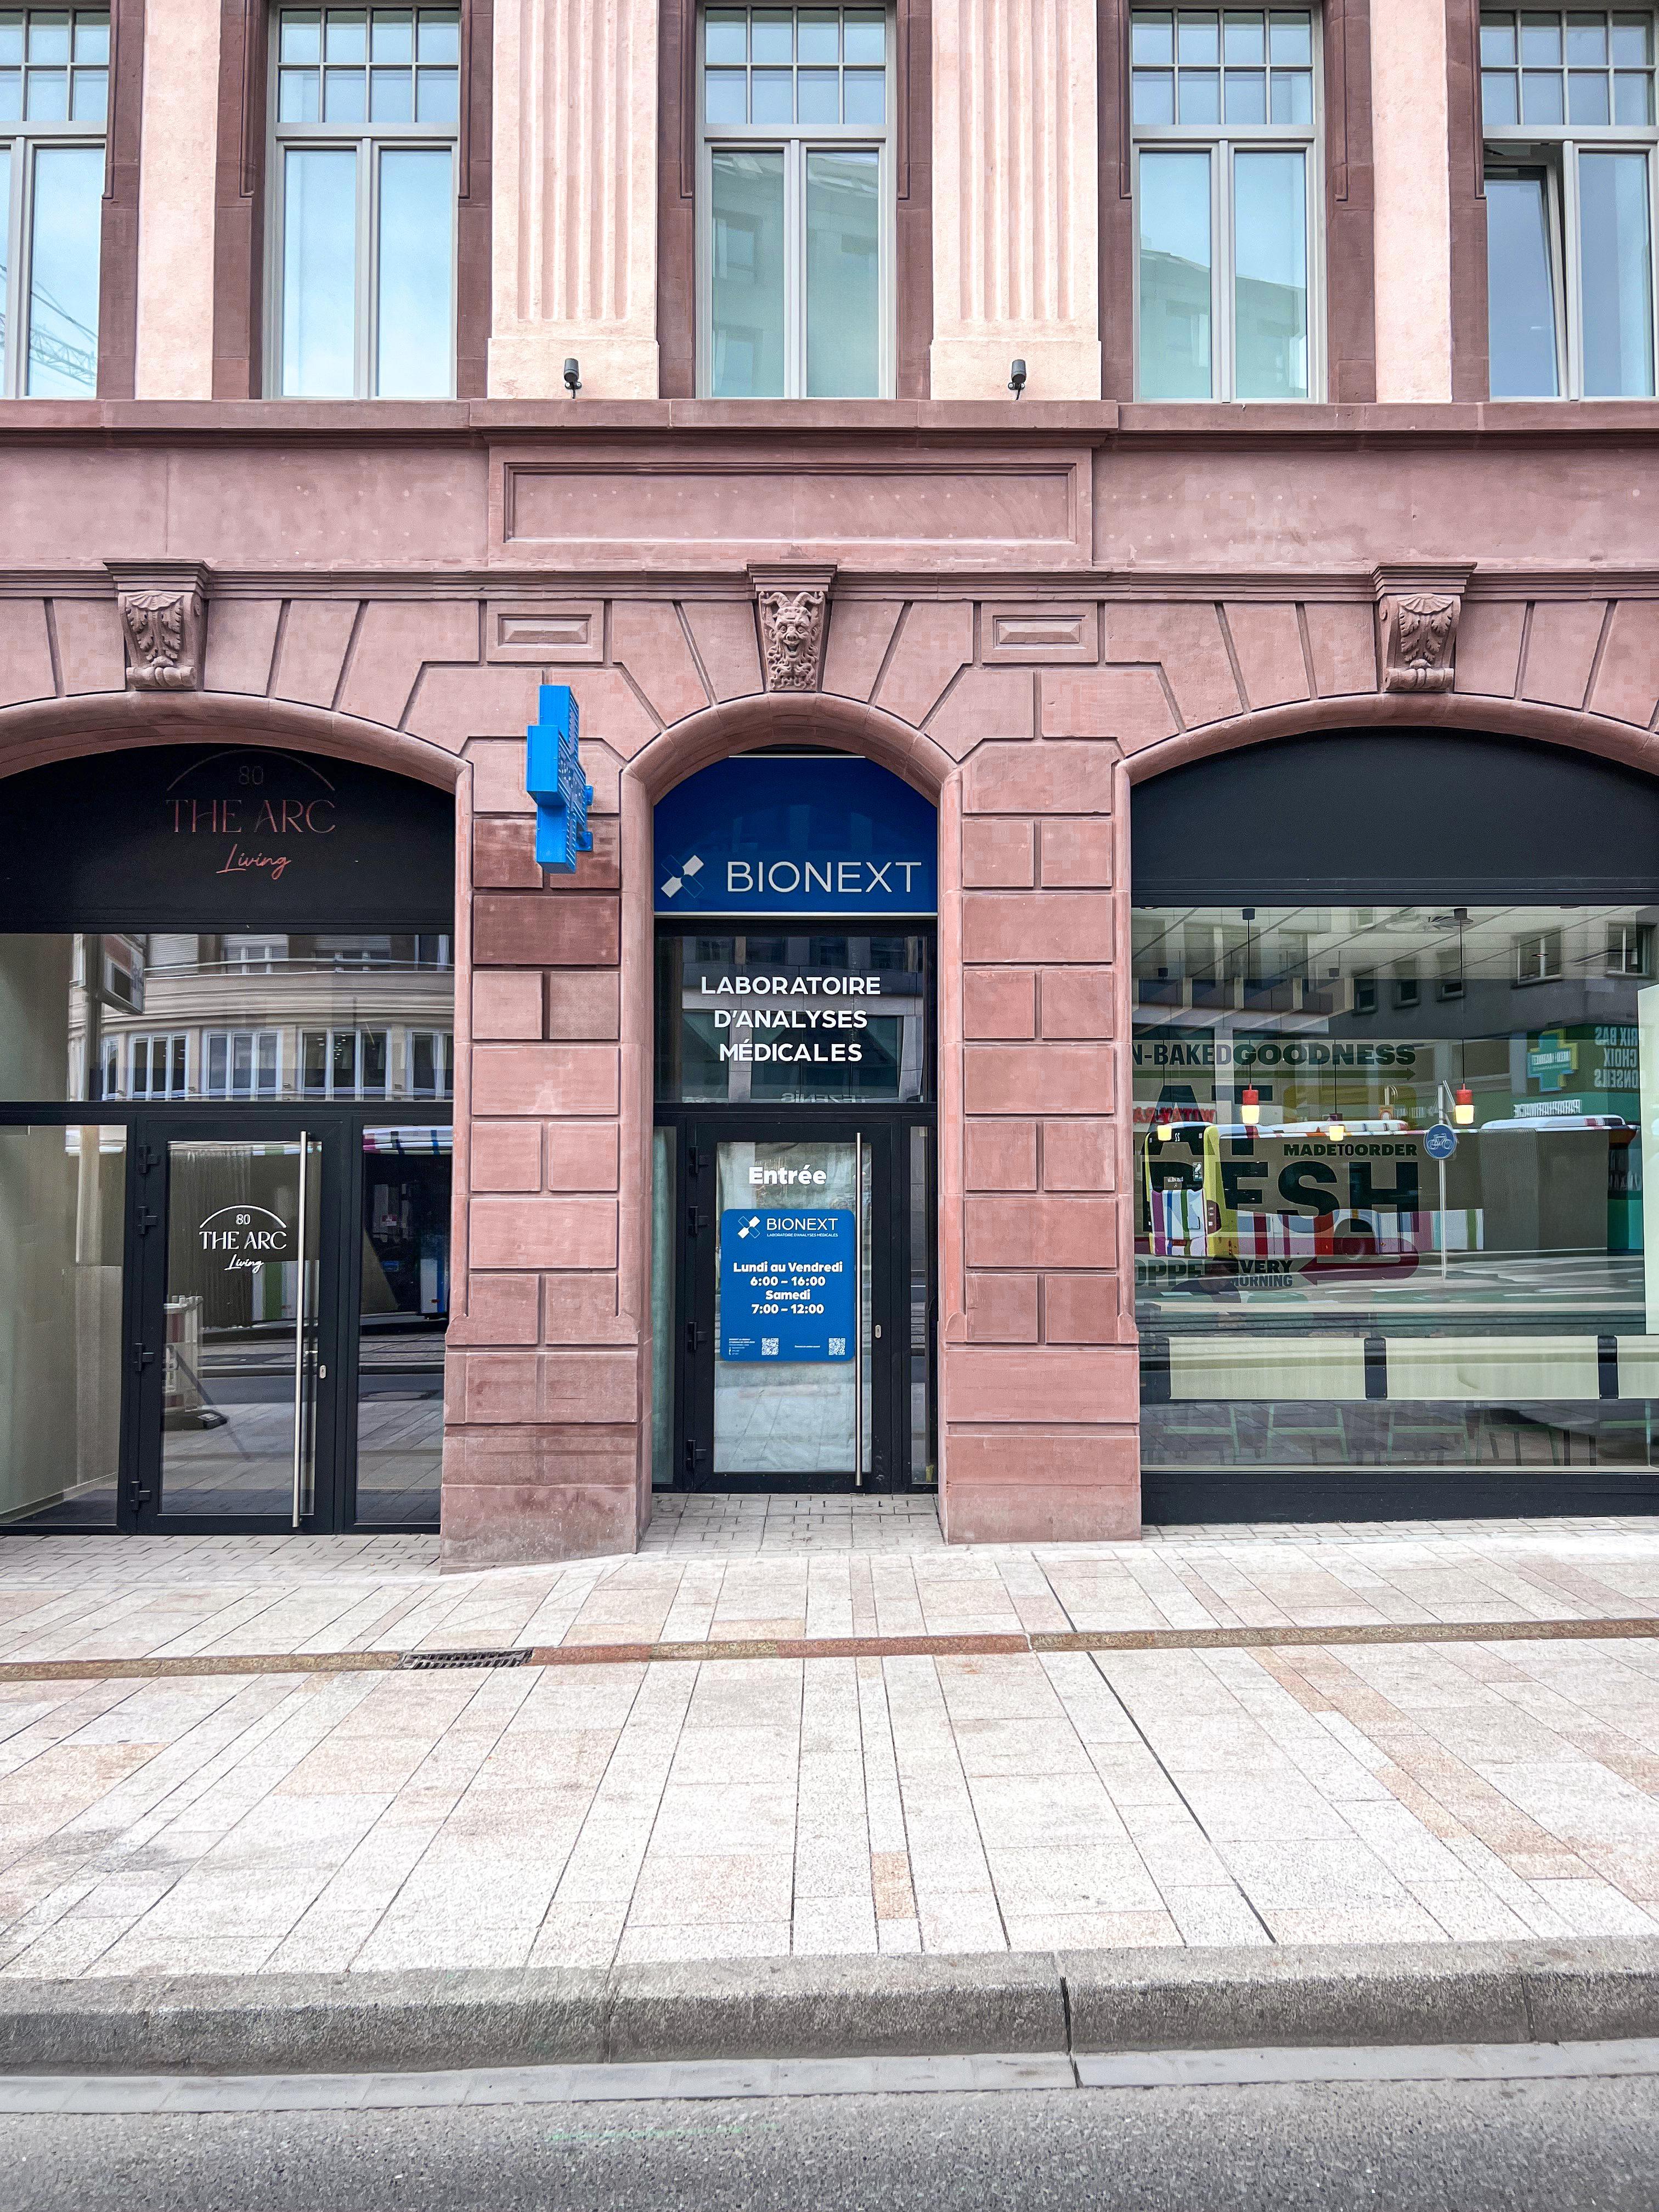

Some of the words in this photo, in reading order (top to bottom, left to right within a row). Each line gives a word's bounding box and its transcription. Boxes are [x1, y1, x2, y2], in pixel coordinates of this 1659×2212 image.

[239, 766, 263, 785] 80
[166, 799, 242, 832] THE
[254, 799, 336, 832] ARC
[216, 844, 291, 879] Living
[727, 861, 922, 893] BIONEXT
[701, 977, 881, 995] LABORATOIRE
[714, 1010, 868, 1028] D'ANALYSES
[720, 1039, 862, 1062] MÉDICALES
[1133, 1085, 1273, 1155] AT
[749, 1164, 827, 1185] Entrée
[236, 1214, 251, 1225] 80
[767, 1218, 838, 1230] BIONEXT
[199, 1231, 240, 1250] THE
[244, 1231, 287, 1250] ARC
[224, 1254, 264, 1274] Living
[733, 1261, 768, 1272] Lundi
[788, 1261, 843, 1272] Vendredi
[750, 1276, 778, 1286] 6:00
[791, 1276, 826, 1286] 16:00
[765, 1289, 811, 1300] Samedi
[751, 1304, 778, 1314] 7:00
[791, 1304, 824, 1314] 12:00
